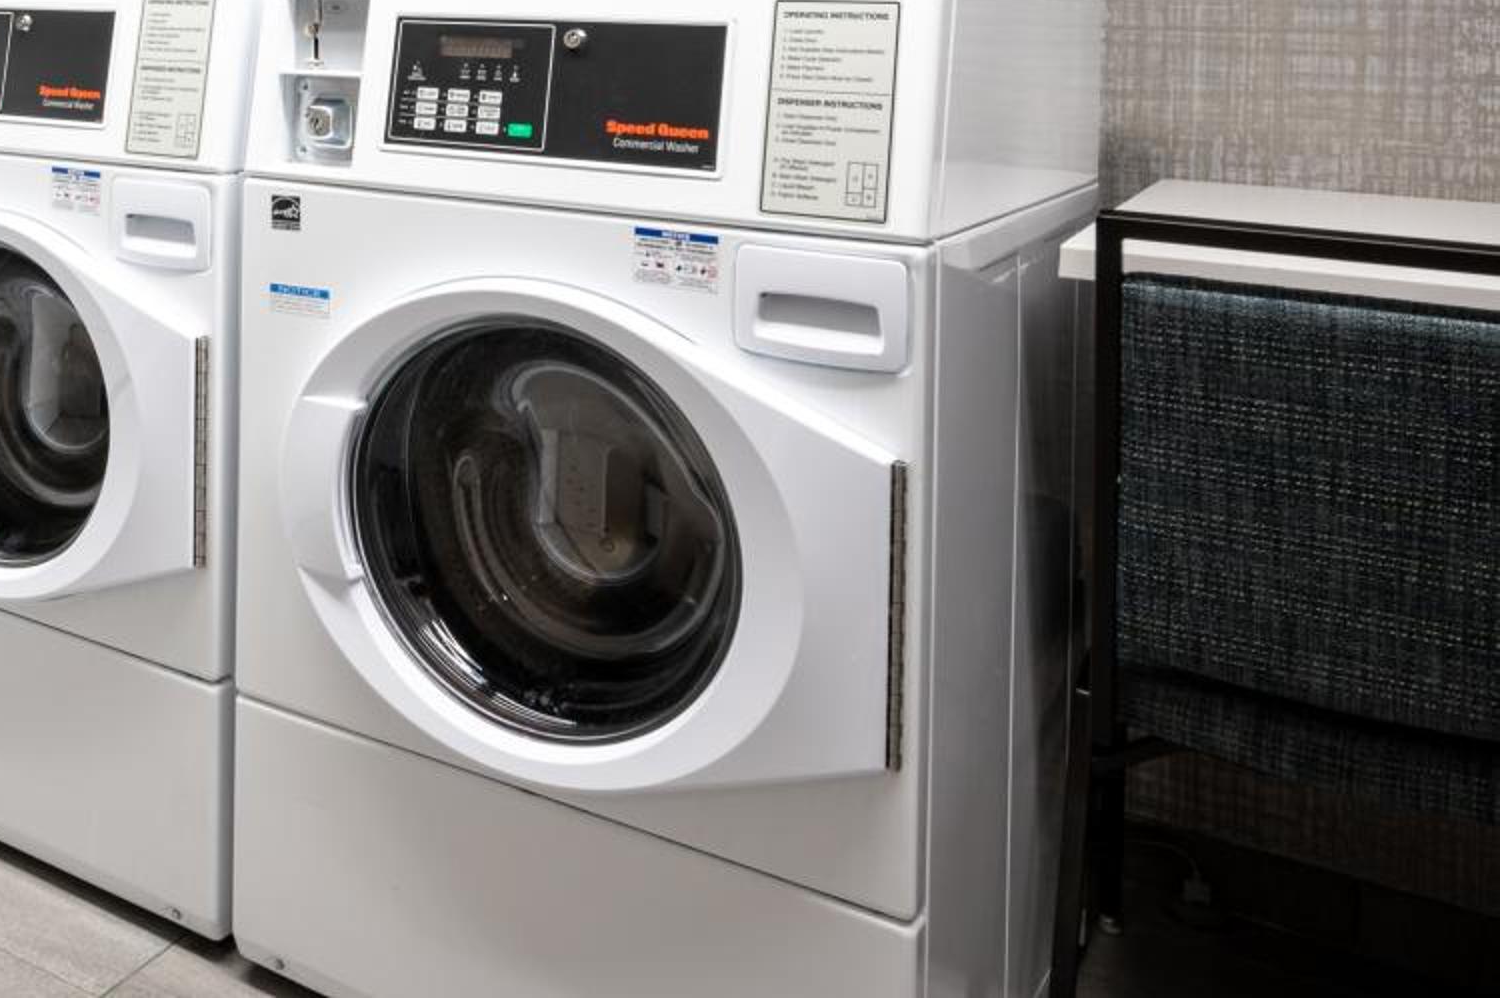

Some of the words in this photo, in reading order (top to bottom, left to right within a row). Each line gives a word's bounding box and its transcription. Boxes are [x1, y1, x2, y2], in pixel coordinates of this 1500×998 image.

[39, 85, 68, 98] Speed
[605, 120, 656, 136] Speed
[658, 123, 709, 139] Queen
[613, 137, 664, 151] Commercial
[666, 141, 699, 153] Washer
